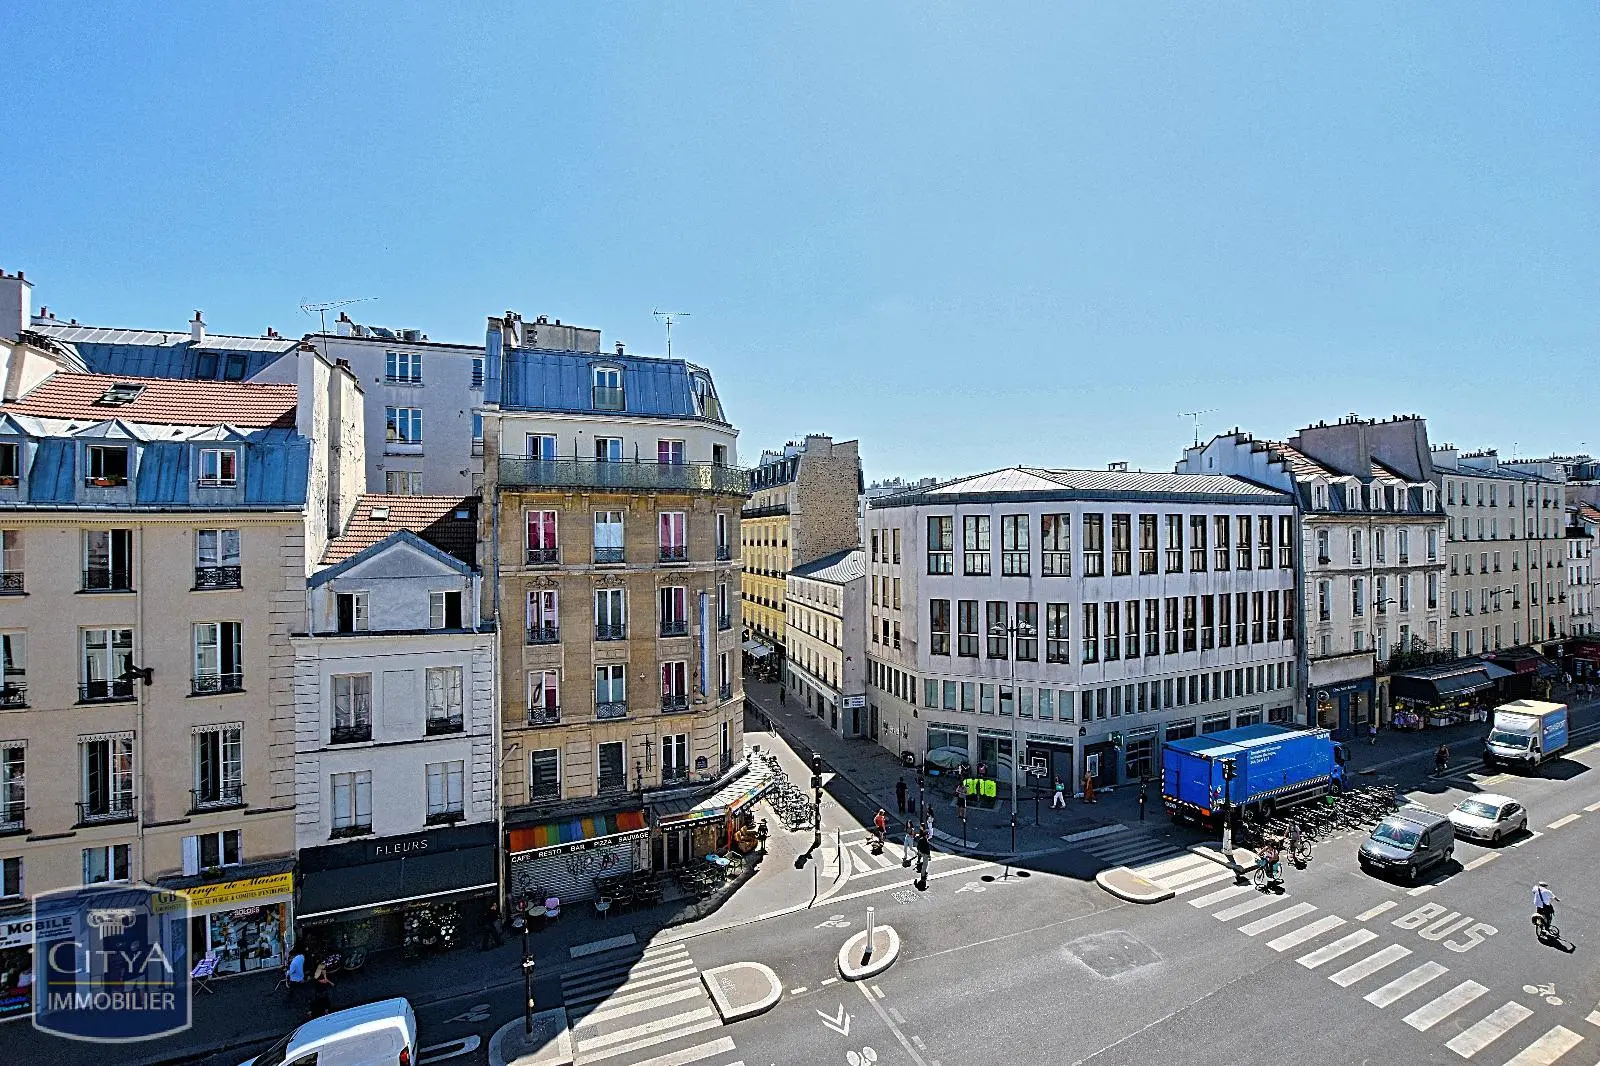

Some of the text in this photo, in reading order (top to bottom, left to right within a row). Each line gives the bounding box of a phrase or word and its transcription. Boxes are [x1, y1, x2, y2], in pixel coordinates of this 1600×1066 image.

[376, 840, 428, 855] FLEURS
[538, 848, 562, 858] RESTO
[570, 844, 586, 852] BAR
[593, 839, 612, 848] PIZZA
[618, 831, 649, 843] SAUVAGE
[8, 916, 72, 935] MOBILE
[1391, 902, 1499, 953] BUS
